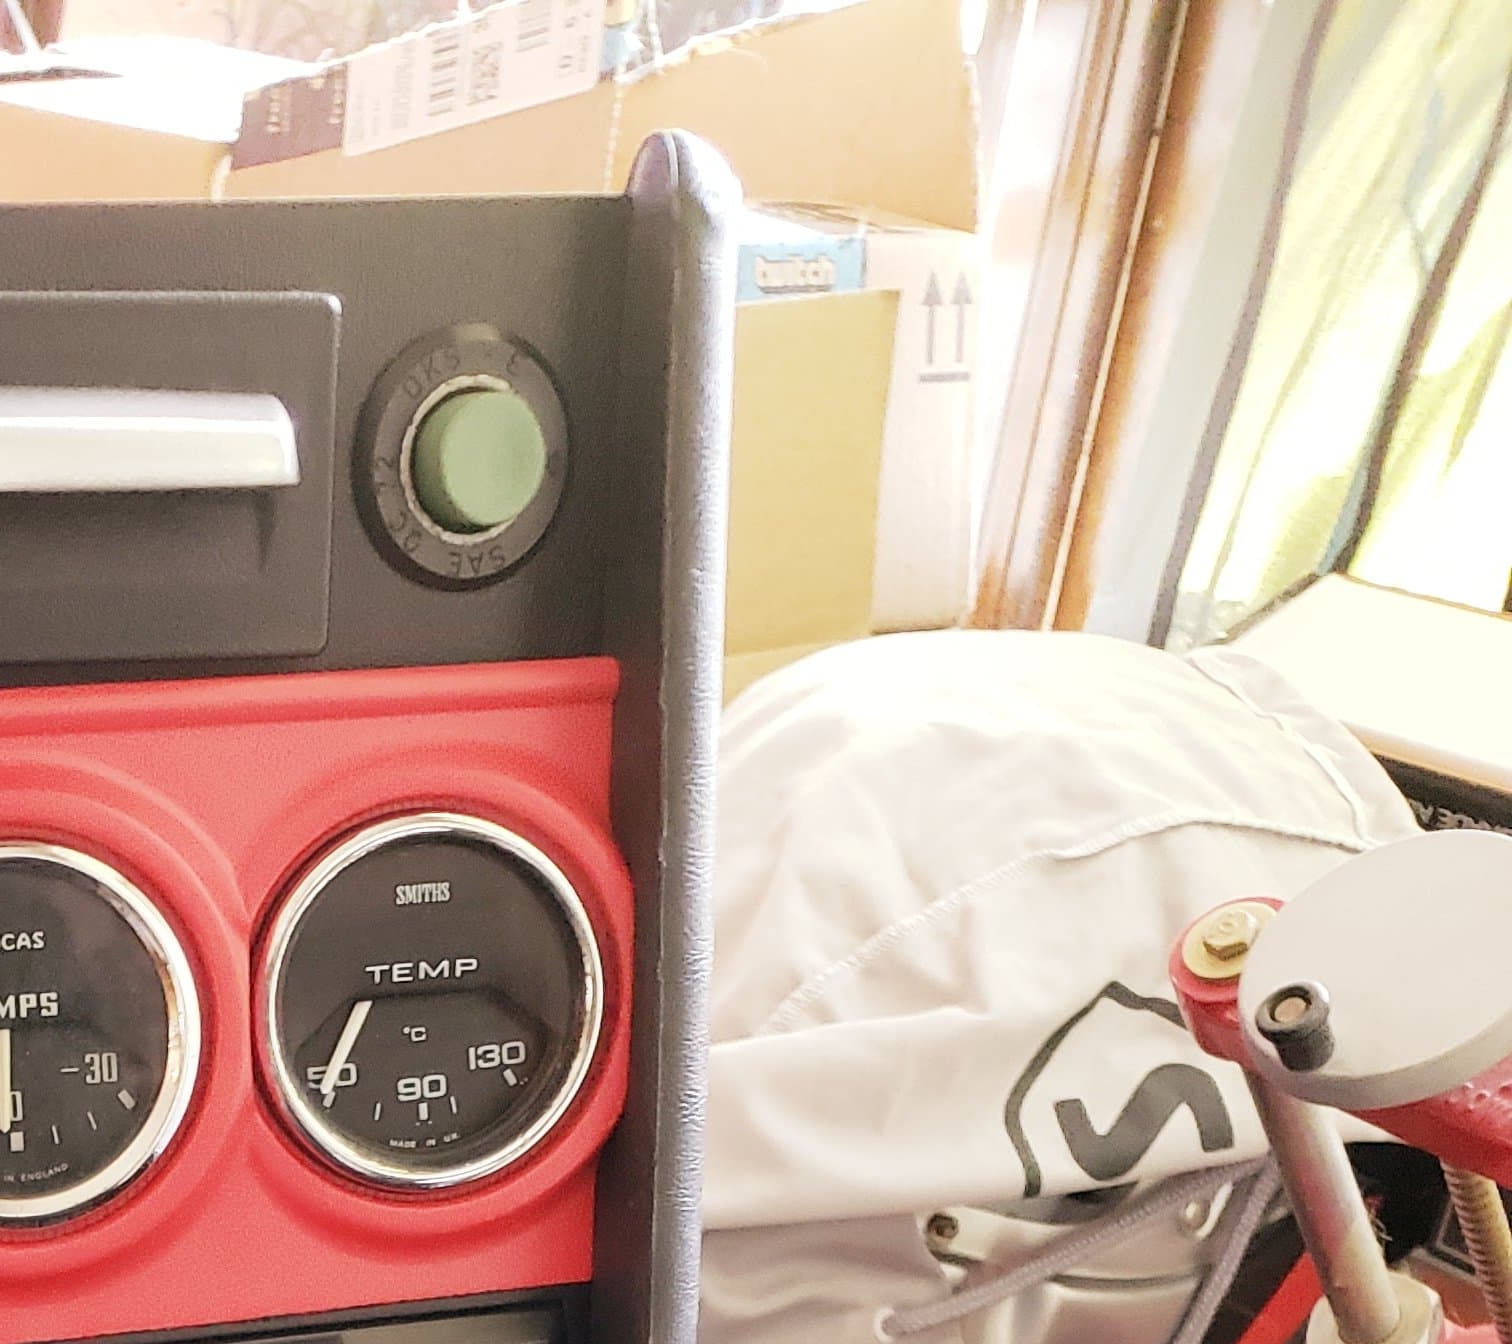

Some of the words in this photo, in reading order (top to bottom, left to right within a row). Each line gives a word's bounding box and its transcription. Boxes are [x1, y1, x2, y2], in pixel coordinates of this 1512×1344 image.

[395, 881, 451, 906] SMITHS
[365, 957, 479, 984] TEMP
[396, 1073, 447, 1102] 90
[468, 1040, 526, 1071] 130
[20, 1162, 68, 1182] ENGLAND
